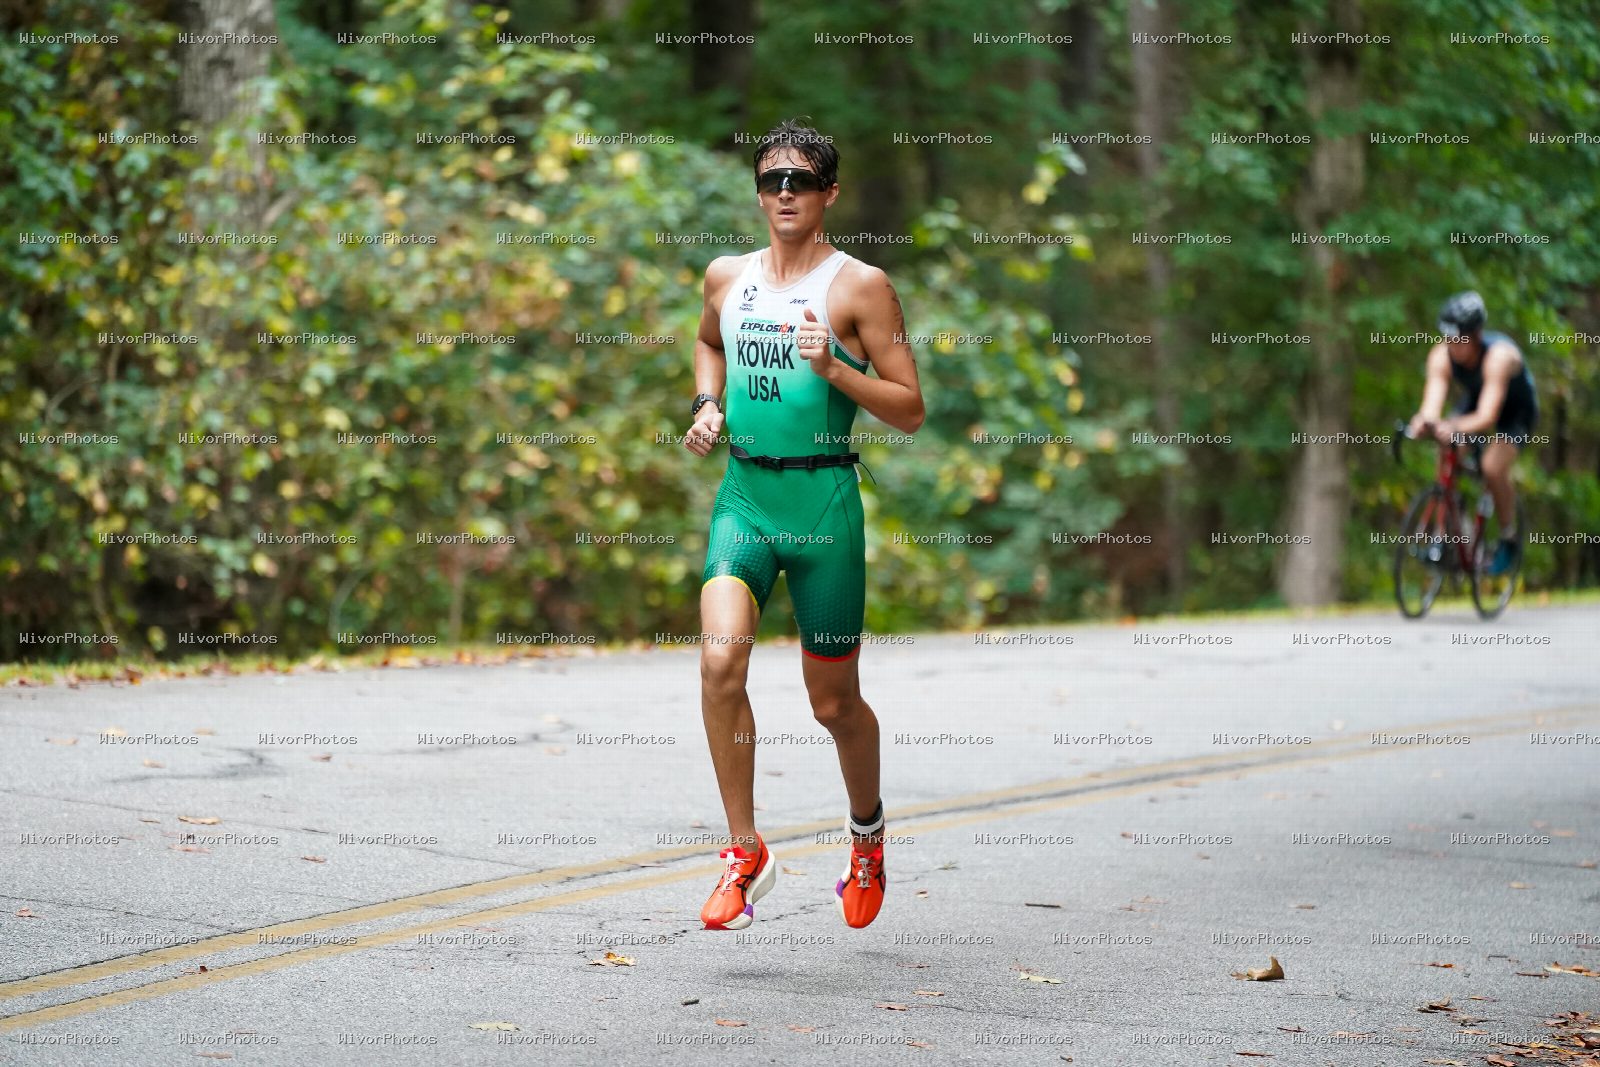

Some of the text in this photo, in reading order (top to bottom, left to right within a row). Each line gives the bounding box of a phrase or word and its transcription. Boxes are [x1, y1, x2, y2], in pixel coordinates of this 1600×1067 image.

[740, 322, 796, 333] EXPLOSION
[737, 340, 795, 369] KOVAK
[748, 375, 782, 402] USA
